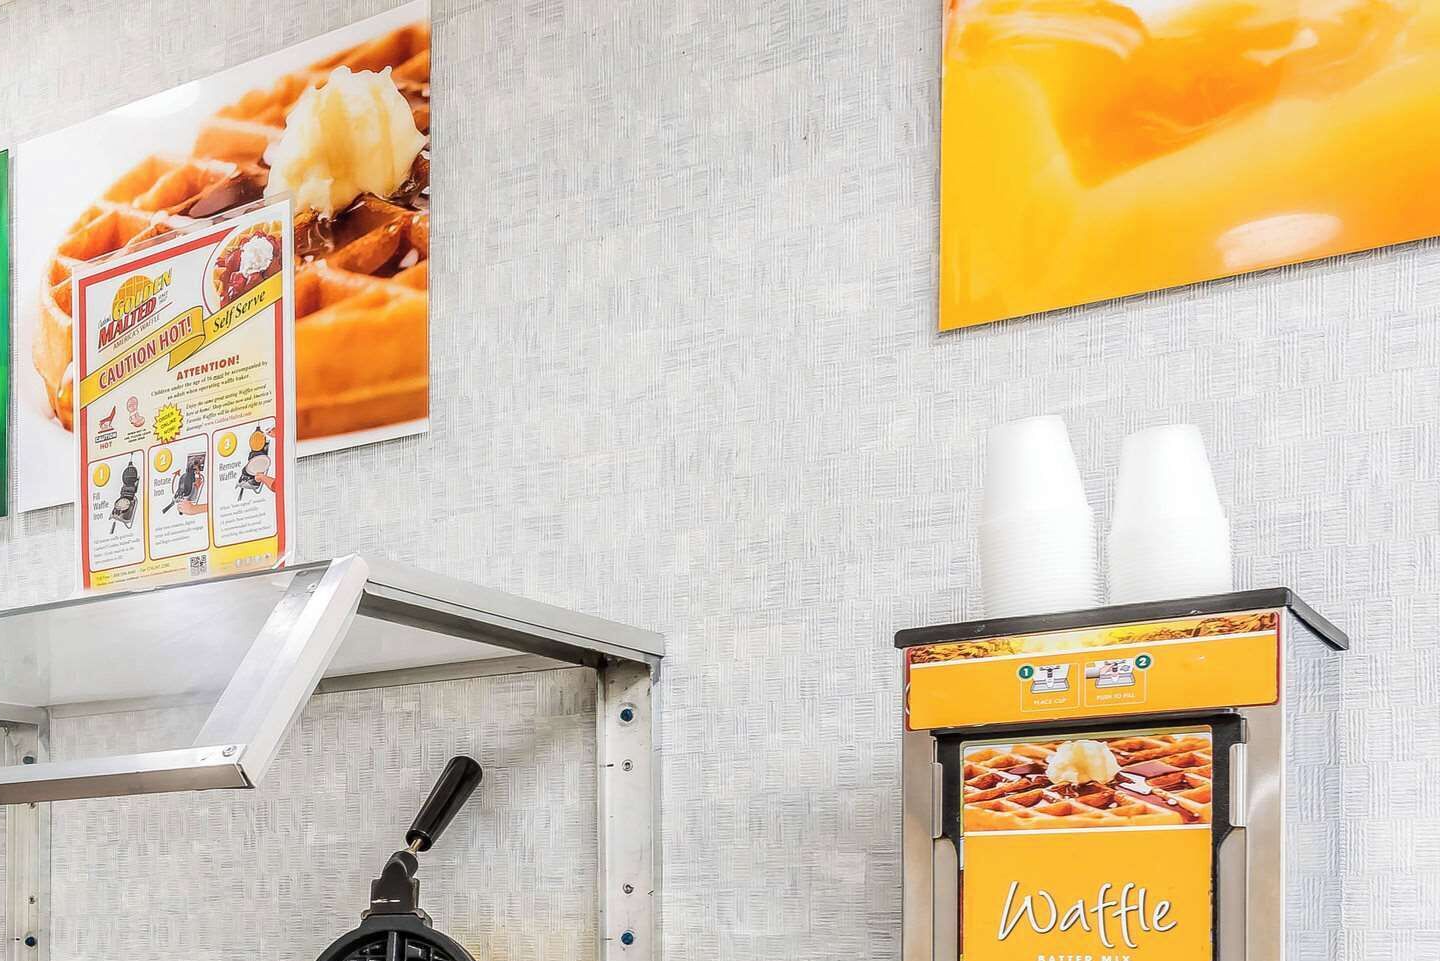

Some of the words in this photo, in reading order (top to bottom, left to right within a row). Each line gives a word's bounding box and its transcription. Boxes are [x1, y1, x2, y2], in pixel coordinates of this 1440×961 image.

[112, 268, 173, 322] GOLDEN
[213, 306, 235, 333] Self
[235, 291, 266, 319] Serve
[98, 297, 157, 350] MALTED
[113, 327, 140, 350] AMERICA'S
[140, 315, 160, 333] WAFFLE
[99, 339, 156, 390] CAUTION
[159, 315, 193, 351] HOT!
[176, 354, 240, 381] ATTENTION!
[151, 387, 170, 397] Children
[171, 384, 184, 392] under
[100, 441, 113, 450] HOT
[219, 461, 241, 472] Remove
[219, 471, 238, 481] Waffle
[154, 477, 171, 487] Rotate
[154, 489, 164, 497] Iron
[93, 500, 109, 511] Waffle
[997, 880, 1178, 949] Waffle
